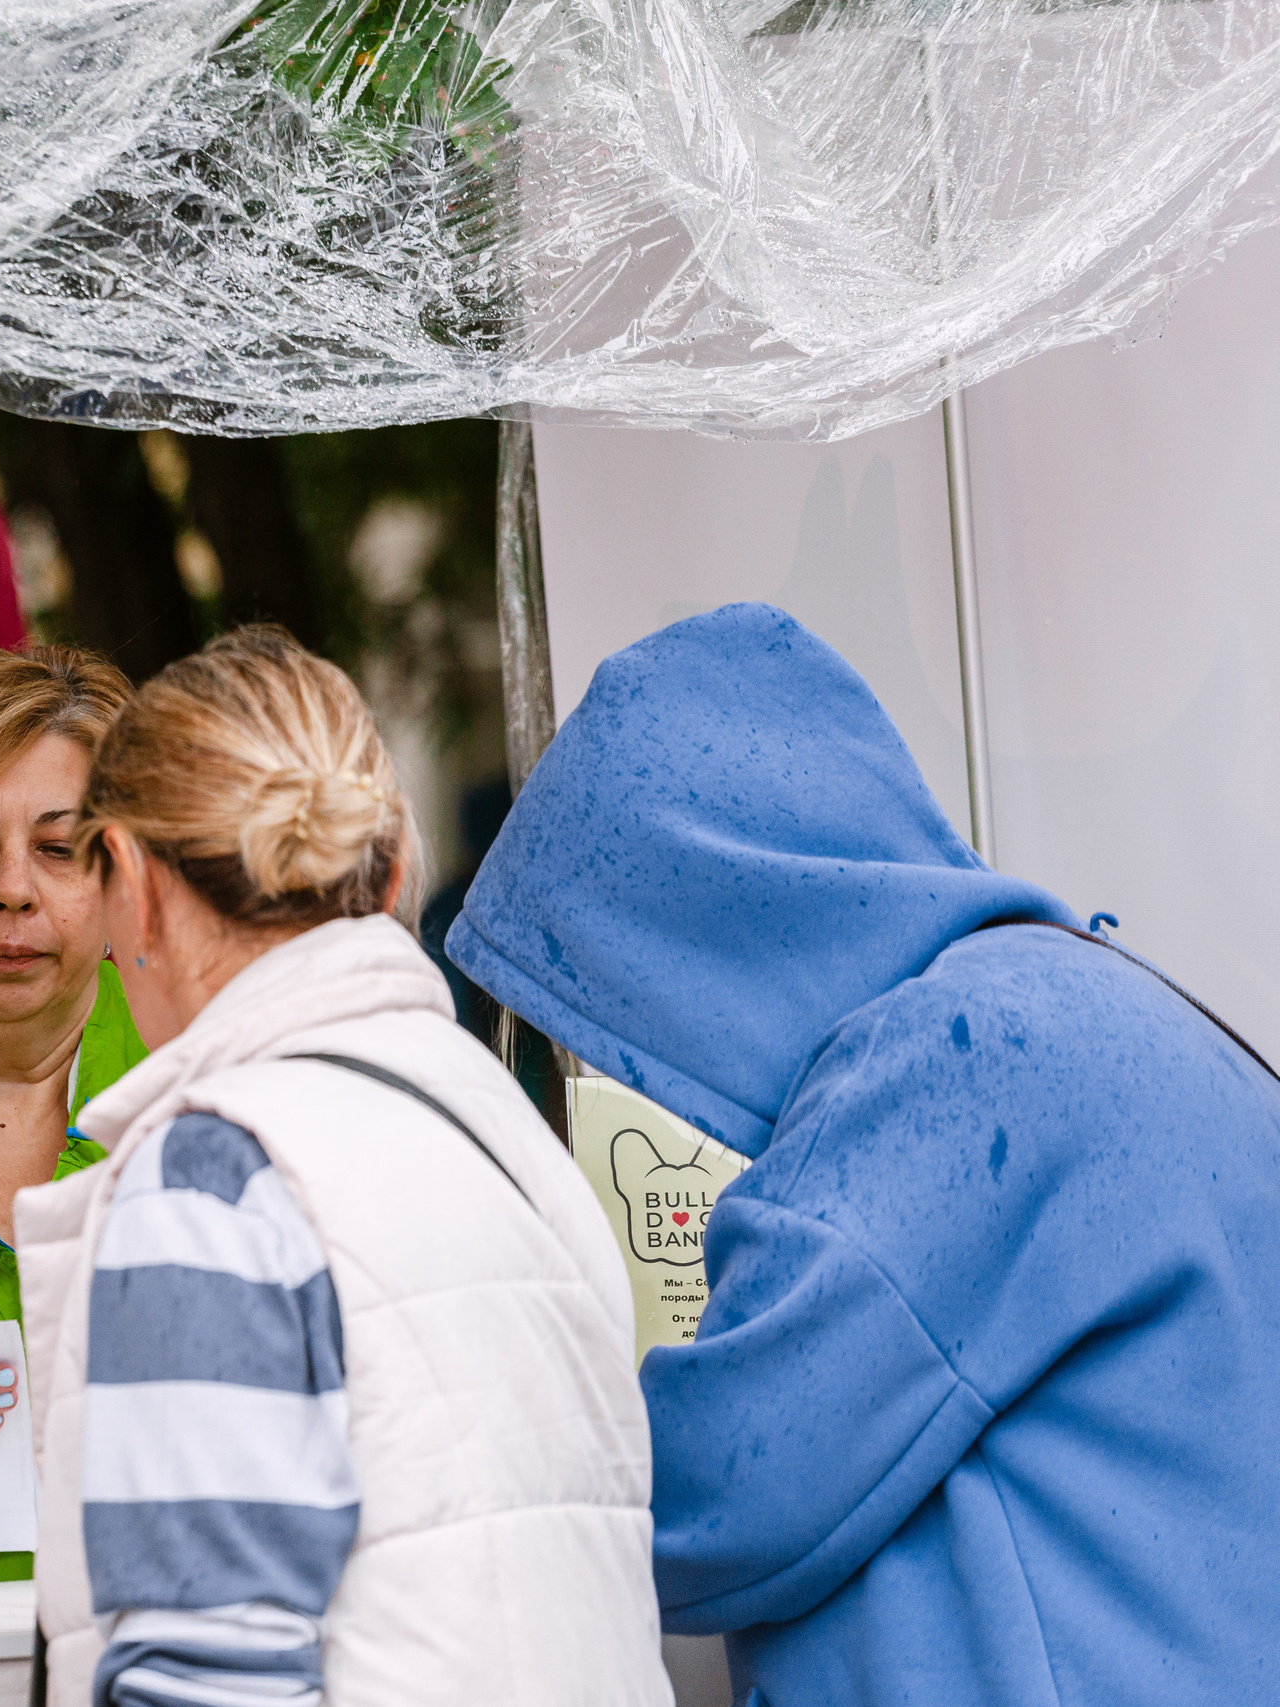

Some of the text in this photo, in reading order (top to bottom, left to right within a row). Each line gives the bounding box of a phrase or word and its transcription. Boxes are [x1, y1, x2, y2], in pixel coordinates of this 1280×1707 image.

[645, 1191, 714, 1209] BULL
[664, 1279, 683, 1287] Мы
[661, 1294, 704, 1303] породы
[672, 1314, 686, 1323] От
